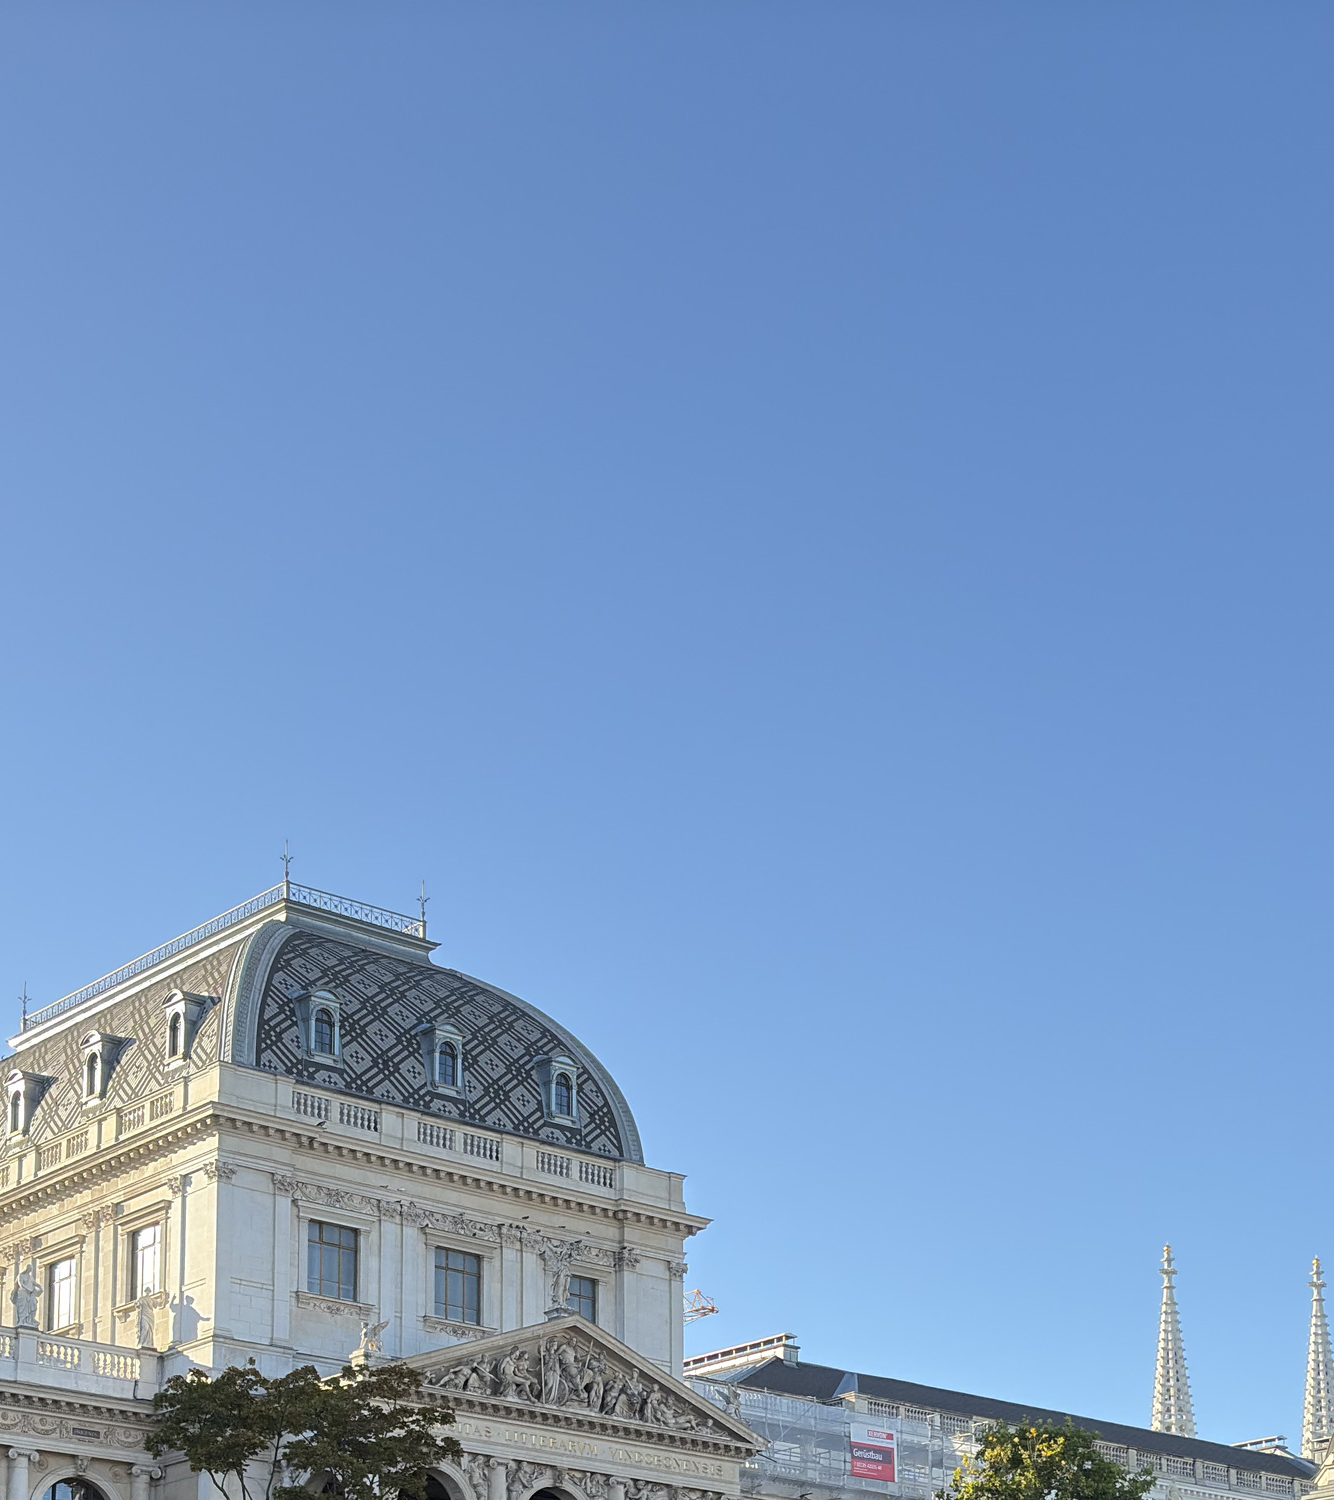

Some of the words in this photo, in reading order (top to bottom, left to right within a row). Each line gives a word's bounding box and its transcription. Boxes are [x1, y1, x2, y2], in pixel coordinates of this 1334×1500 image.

[504, 1430, 598, 1456] LITTERARVM
[609, 1447, 724, 1477] VINDOBONENSIS
[853, 1448, 883, 1460] Gerüstbau
